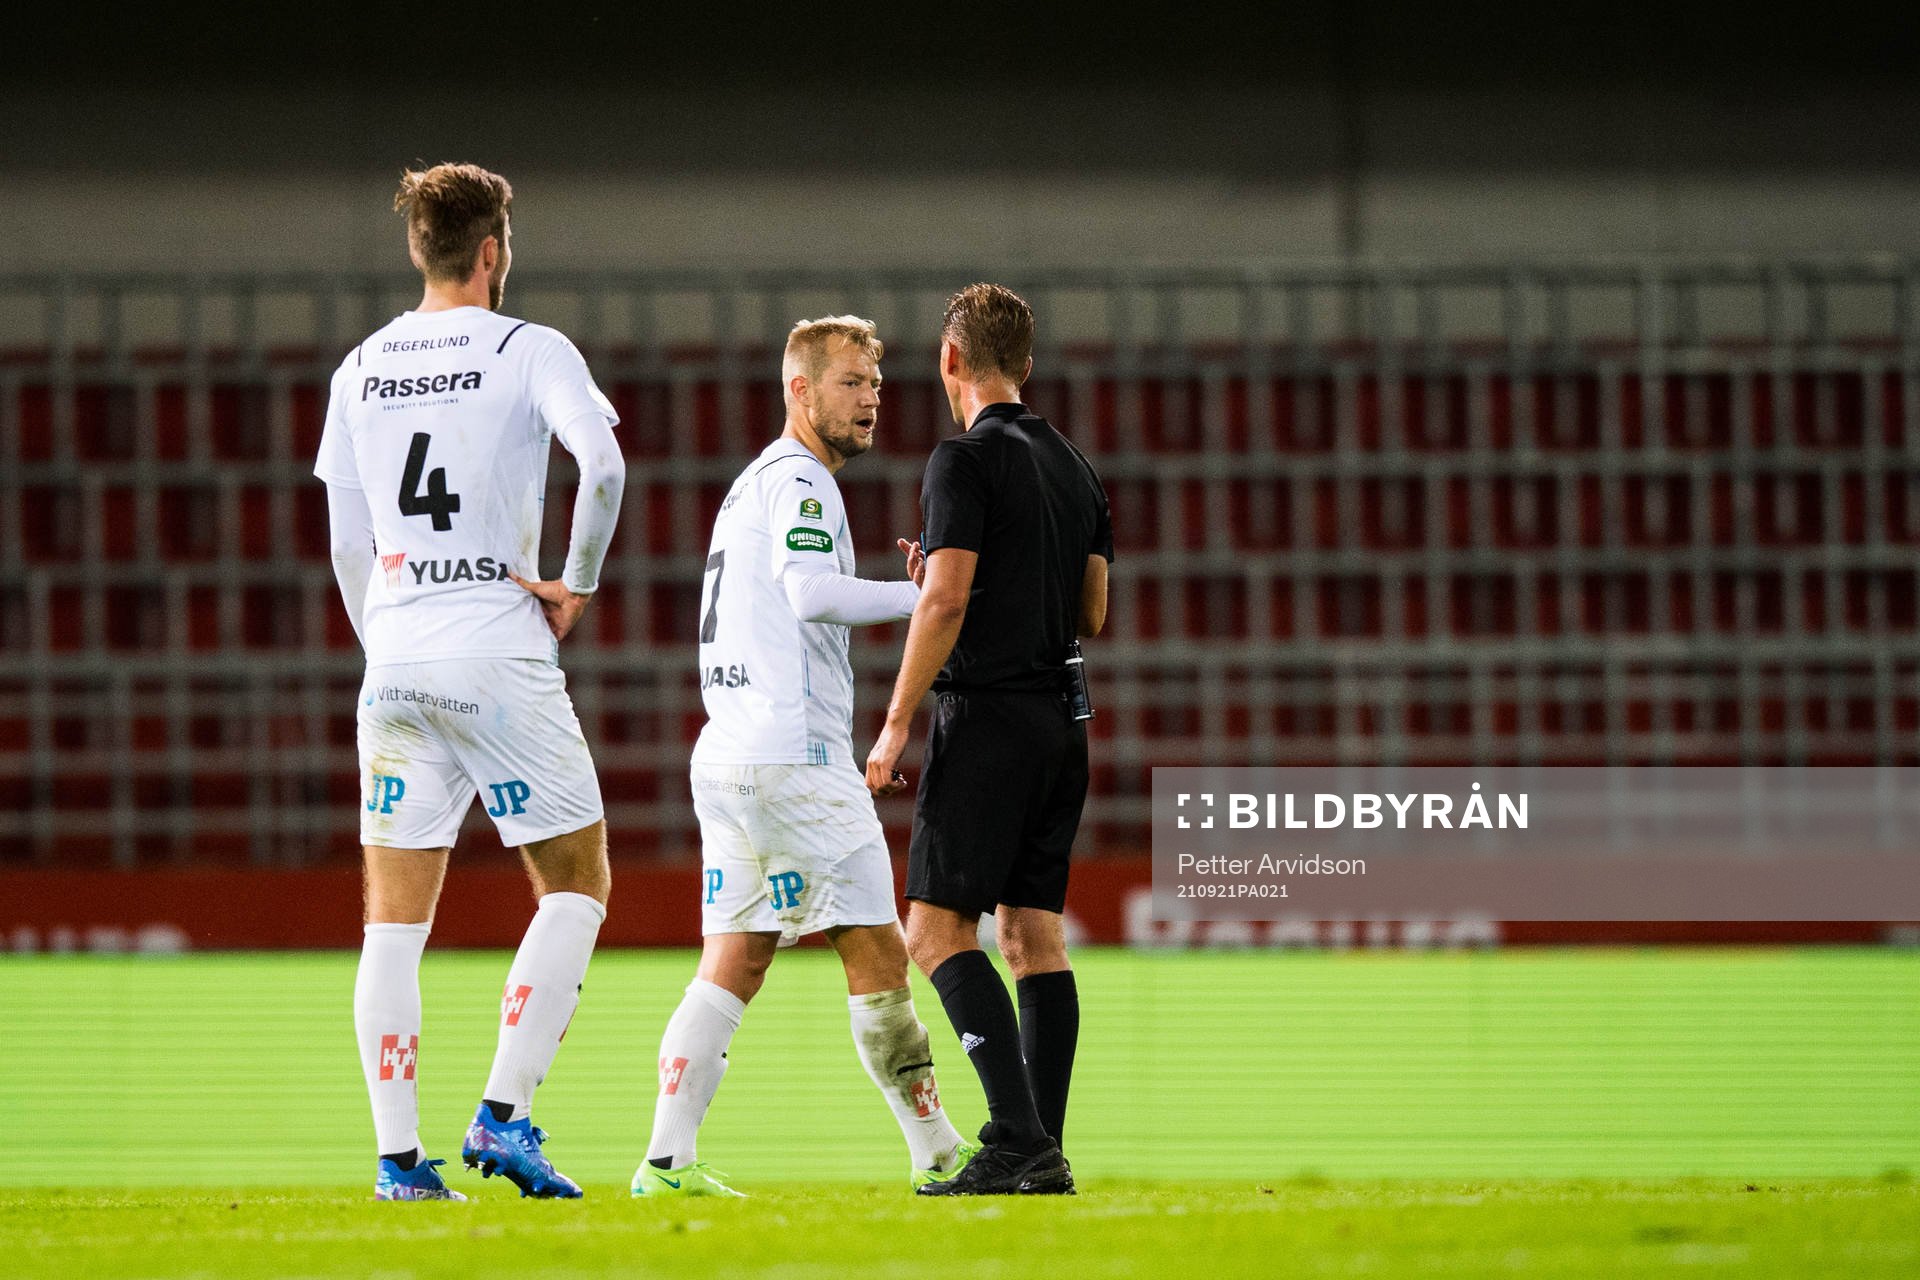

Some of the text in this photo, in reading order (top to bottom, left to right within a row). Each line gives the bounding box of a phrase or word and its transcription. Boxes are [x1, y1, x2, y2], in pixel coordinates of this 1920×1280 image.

[382, 335, 470, 353] DEGERLUND
[361, 371, 483, 402] Passera
[398, 432, 461, 531] 4
[789, 532, 830, 545] UNIBET
[700, 549, 725, 644] 7
[701, 664, 751, 690] UASA
[377, 686, 479, 715] Vithalatvätten
[367, 774, 405, 814] JP
[488, 780, 531, 818] JP
[767, 871, 805, 910] JP
